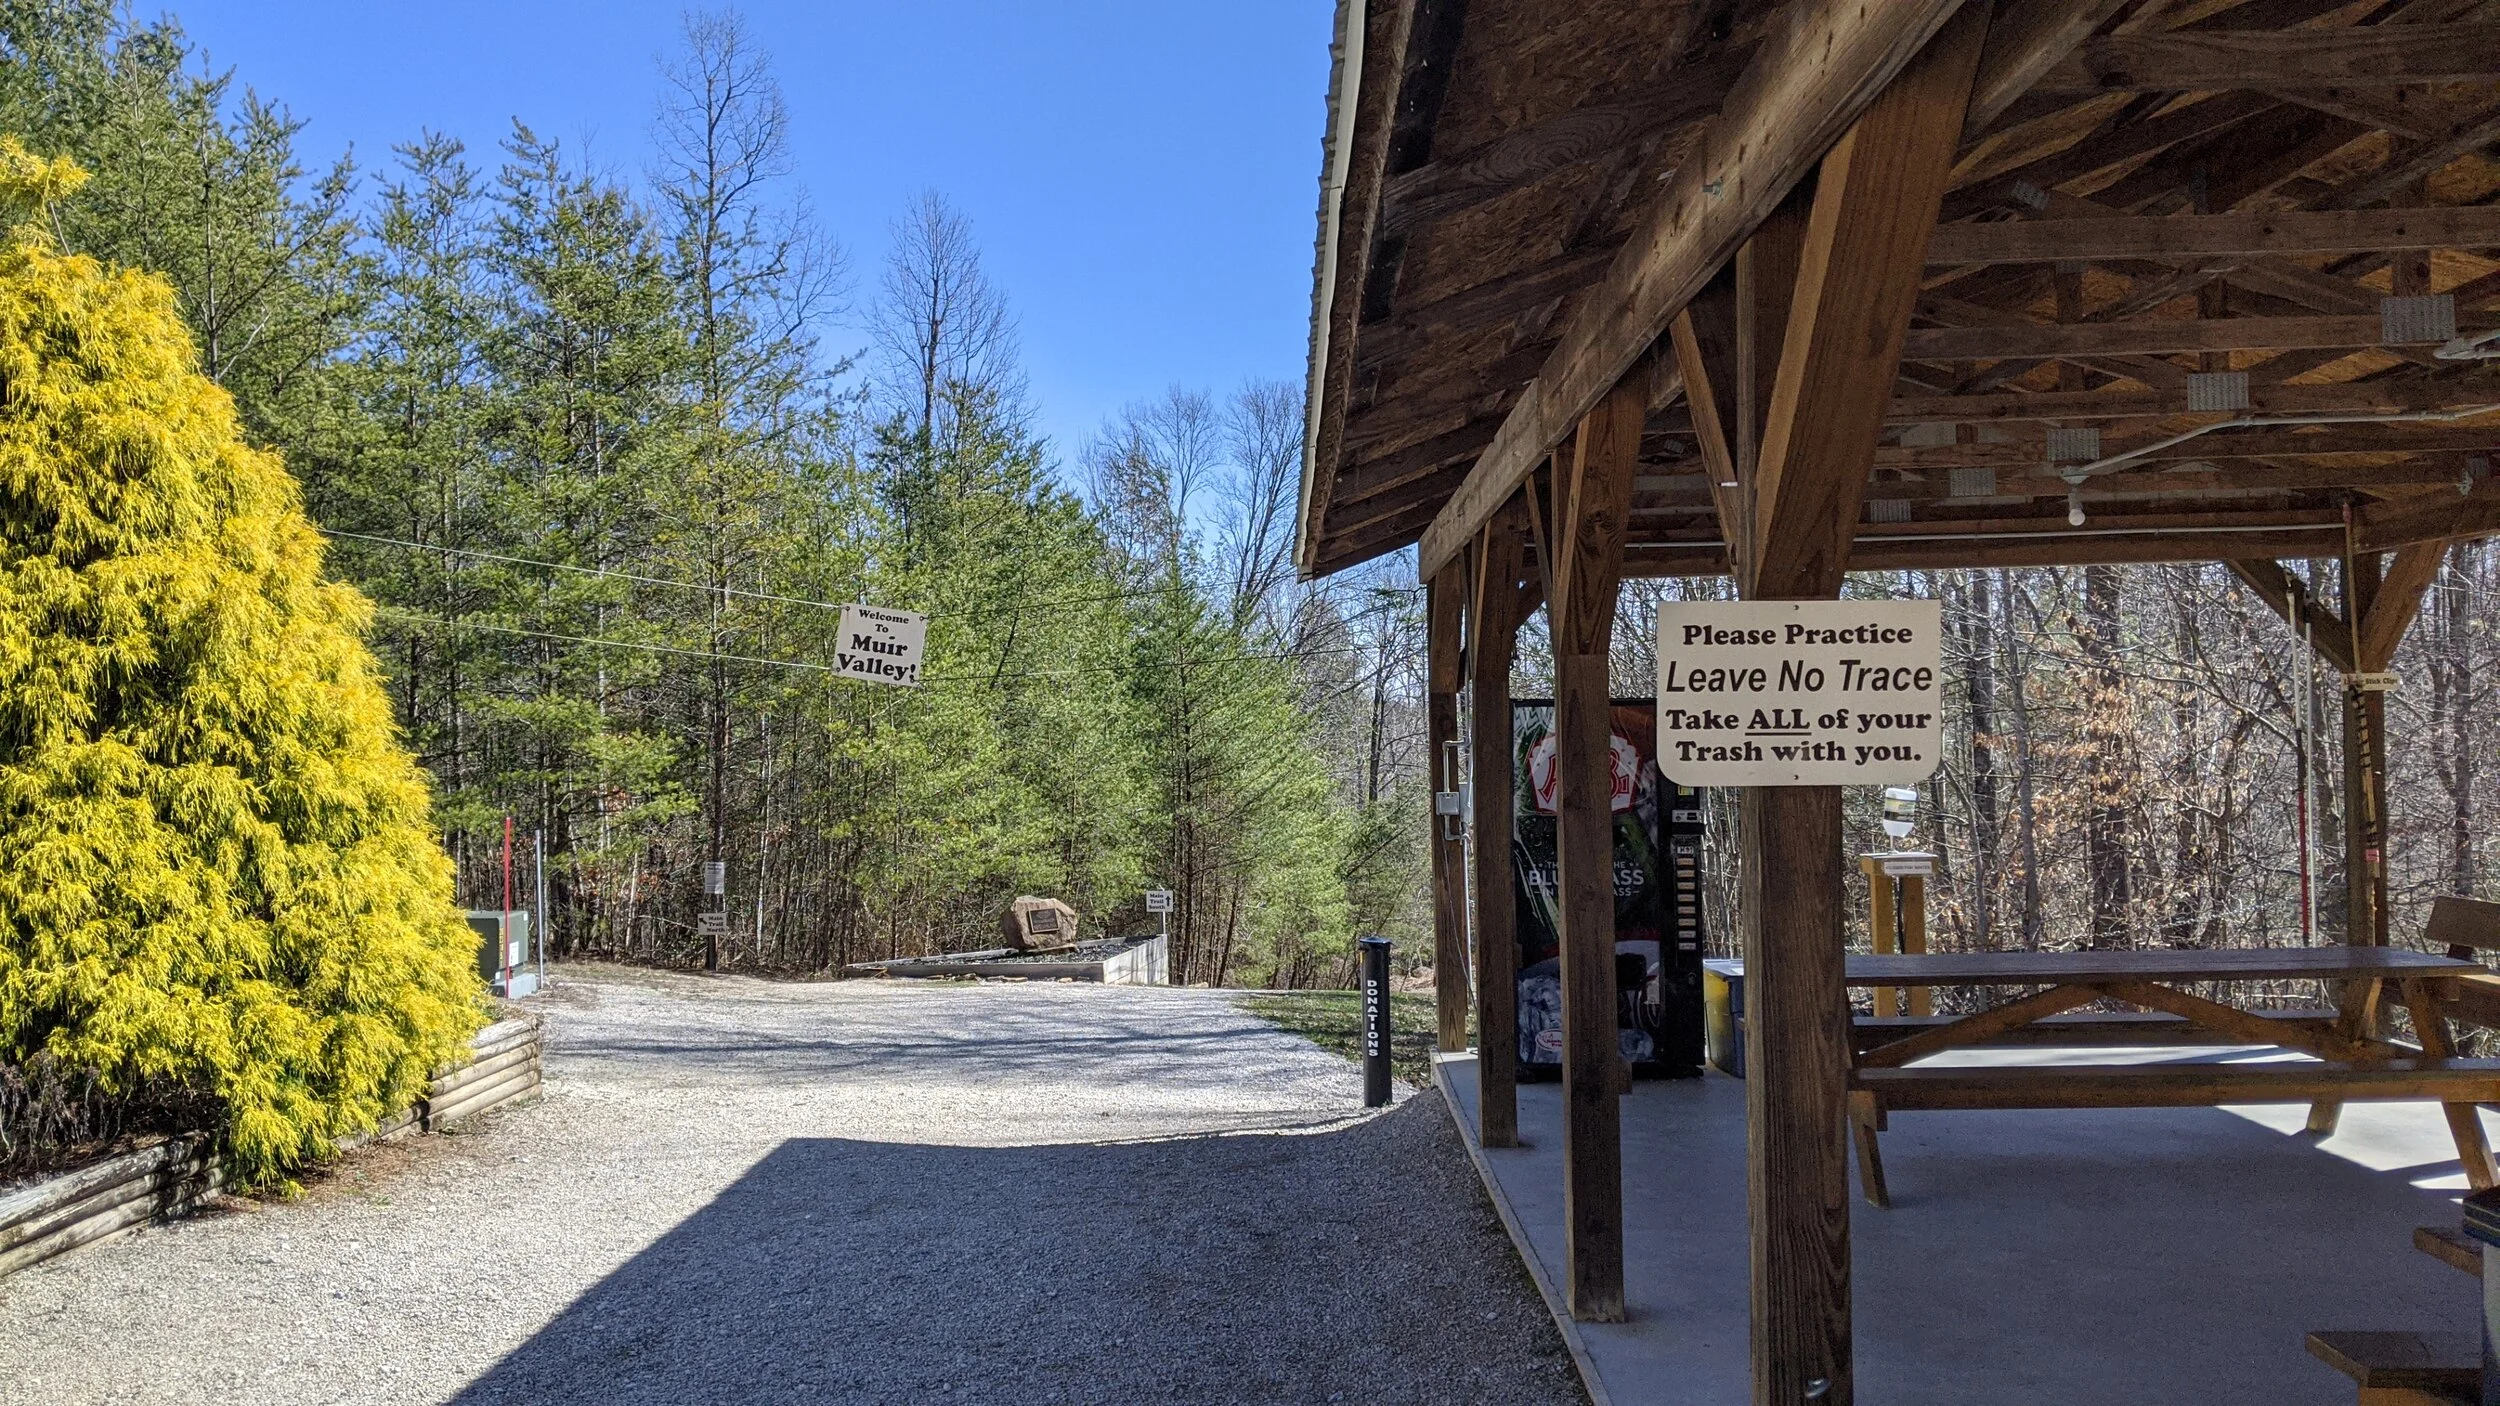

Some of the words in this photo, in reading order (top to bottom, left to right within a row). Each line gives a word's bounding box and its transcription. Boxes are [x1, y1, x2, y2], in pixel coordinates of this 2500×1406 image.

[859, 608, 910, 624] Welcome
[875, 623, 889, 633] To
[851, 634, 908, 656] Muir
[1682, 624, 1777, 645] Please
[1785, 623, 1913, 645] Practice
[837, 653, 917, 681] Valley!
[1665, 660, 1767, 692] Leave
[1778, 659, 1825, 692] No
[1839, 659, 1933, 692] Trace
[1665, 708, 1740, 730] Take
[1746, 708, 1811, 730] ALL
[1817, 708, 1850, 730] of
[1857, 712, 1932, 733] your
[1675, 740, 1764, 762] Trash
[1770, 740, 1847, 762] with
[1854, 744, 1923, 765] you.
[1367, 979, 1379, 1057] DONATIONS
